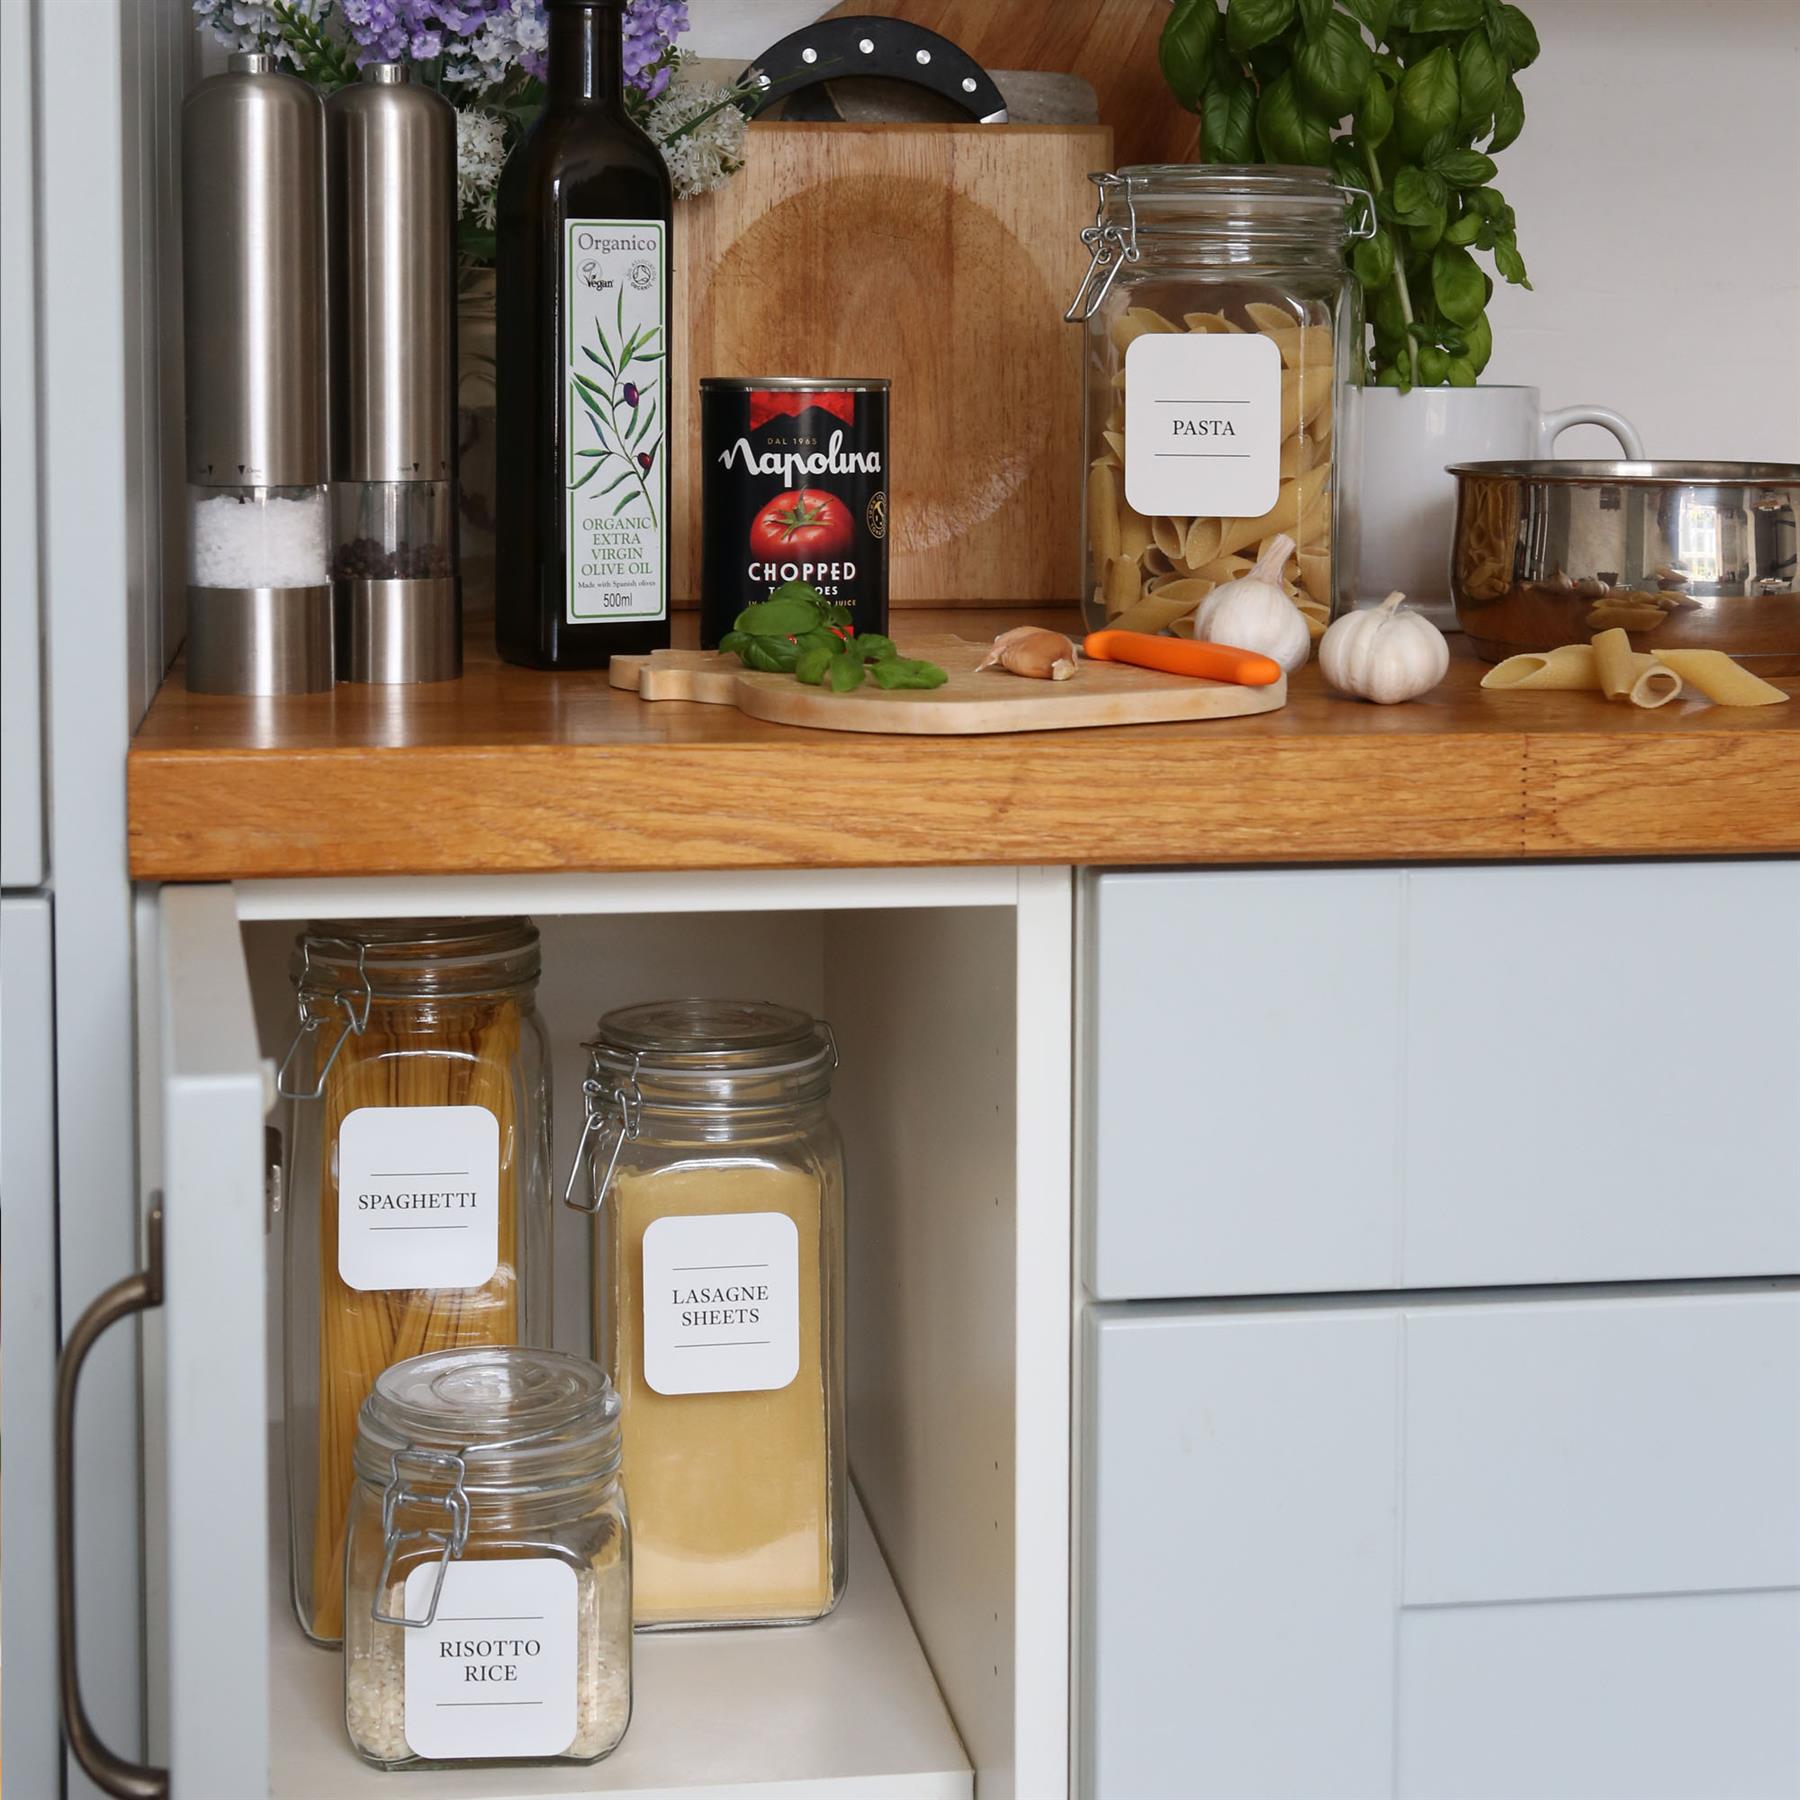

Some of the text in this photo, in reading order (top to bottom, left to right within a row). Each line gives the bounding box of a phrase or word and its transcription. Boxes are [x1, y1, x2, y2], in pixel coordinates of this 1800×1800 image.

[578, 232, 657, 255] Organico
[1172, 419, 1236, 436] PASTA
[767, 437, 817, 445] DAL 1965
[718, 429, 882, 488] Napolina
[582, 517, 652, 531] ORGANIC
[593, 533, 641, 546] EXTRA
[591, 547, 643, 560] VIRGIN
[581, 562, 653, 576] OLIVE OIL
[748, 562, 856, 581] CHOPPED
[577, 581, 596, 589] Made
[612, 580, 637, 589] Spanish
[768, 586, 839, 595] TOES
[603, 592, 633, 608] 500ml
[358, 1192, 477, 1210] SPAGHETTI
[672, 1285, 769, 1305] LASAGNE
[681, 1308, 760, 1327] SHEETS
[439, 1639, 541, 1658] RISOTTO
[464, 1664, 518, 1682] RICE
